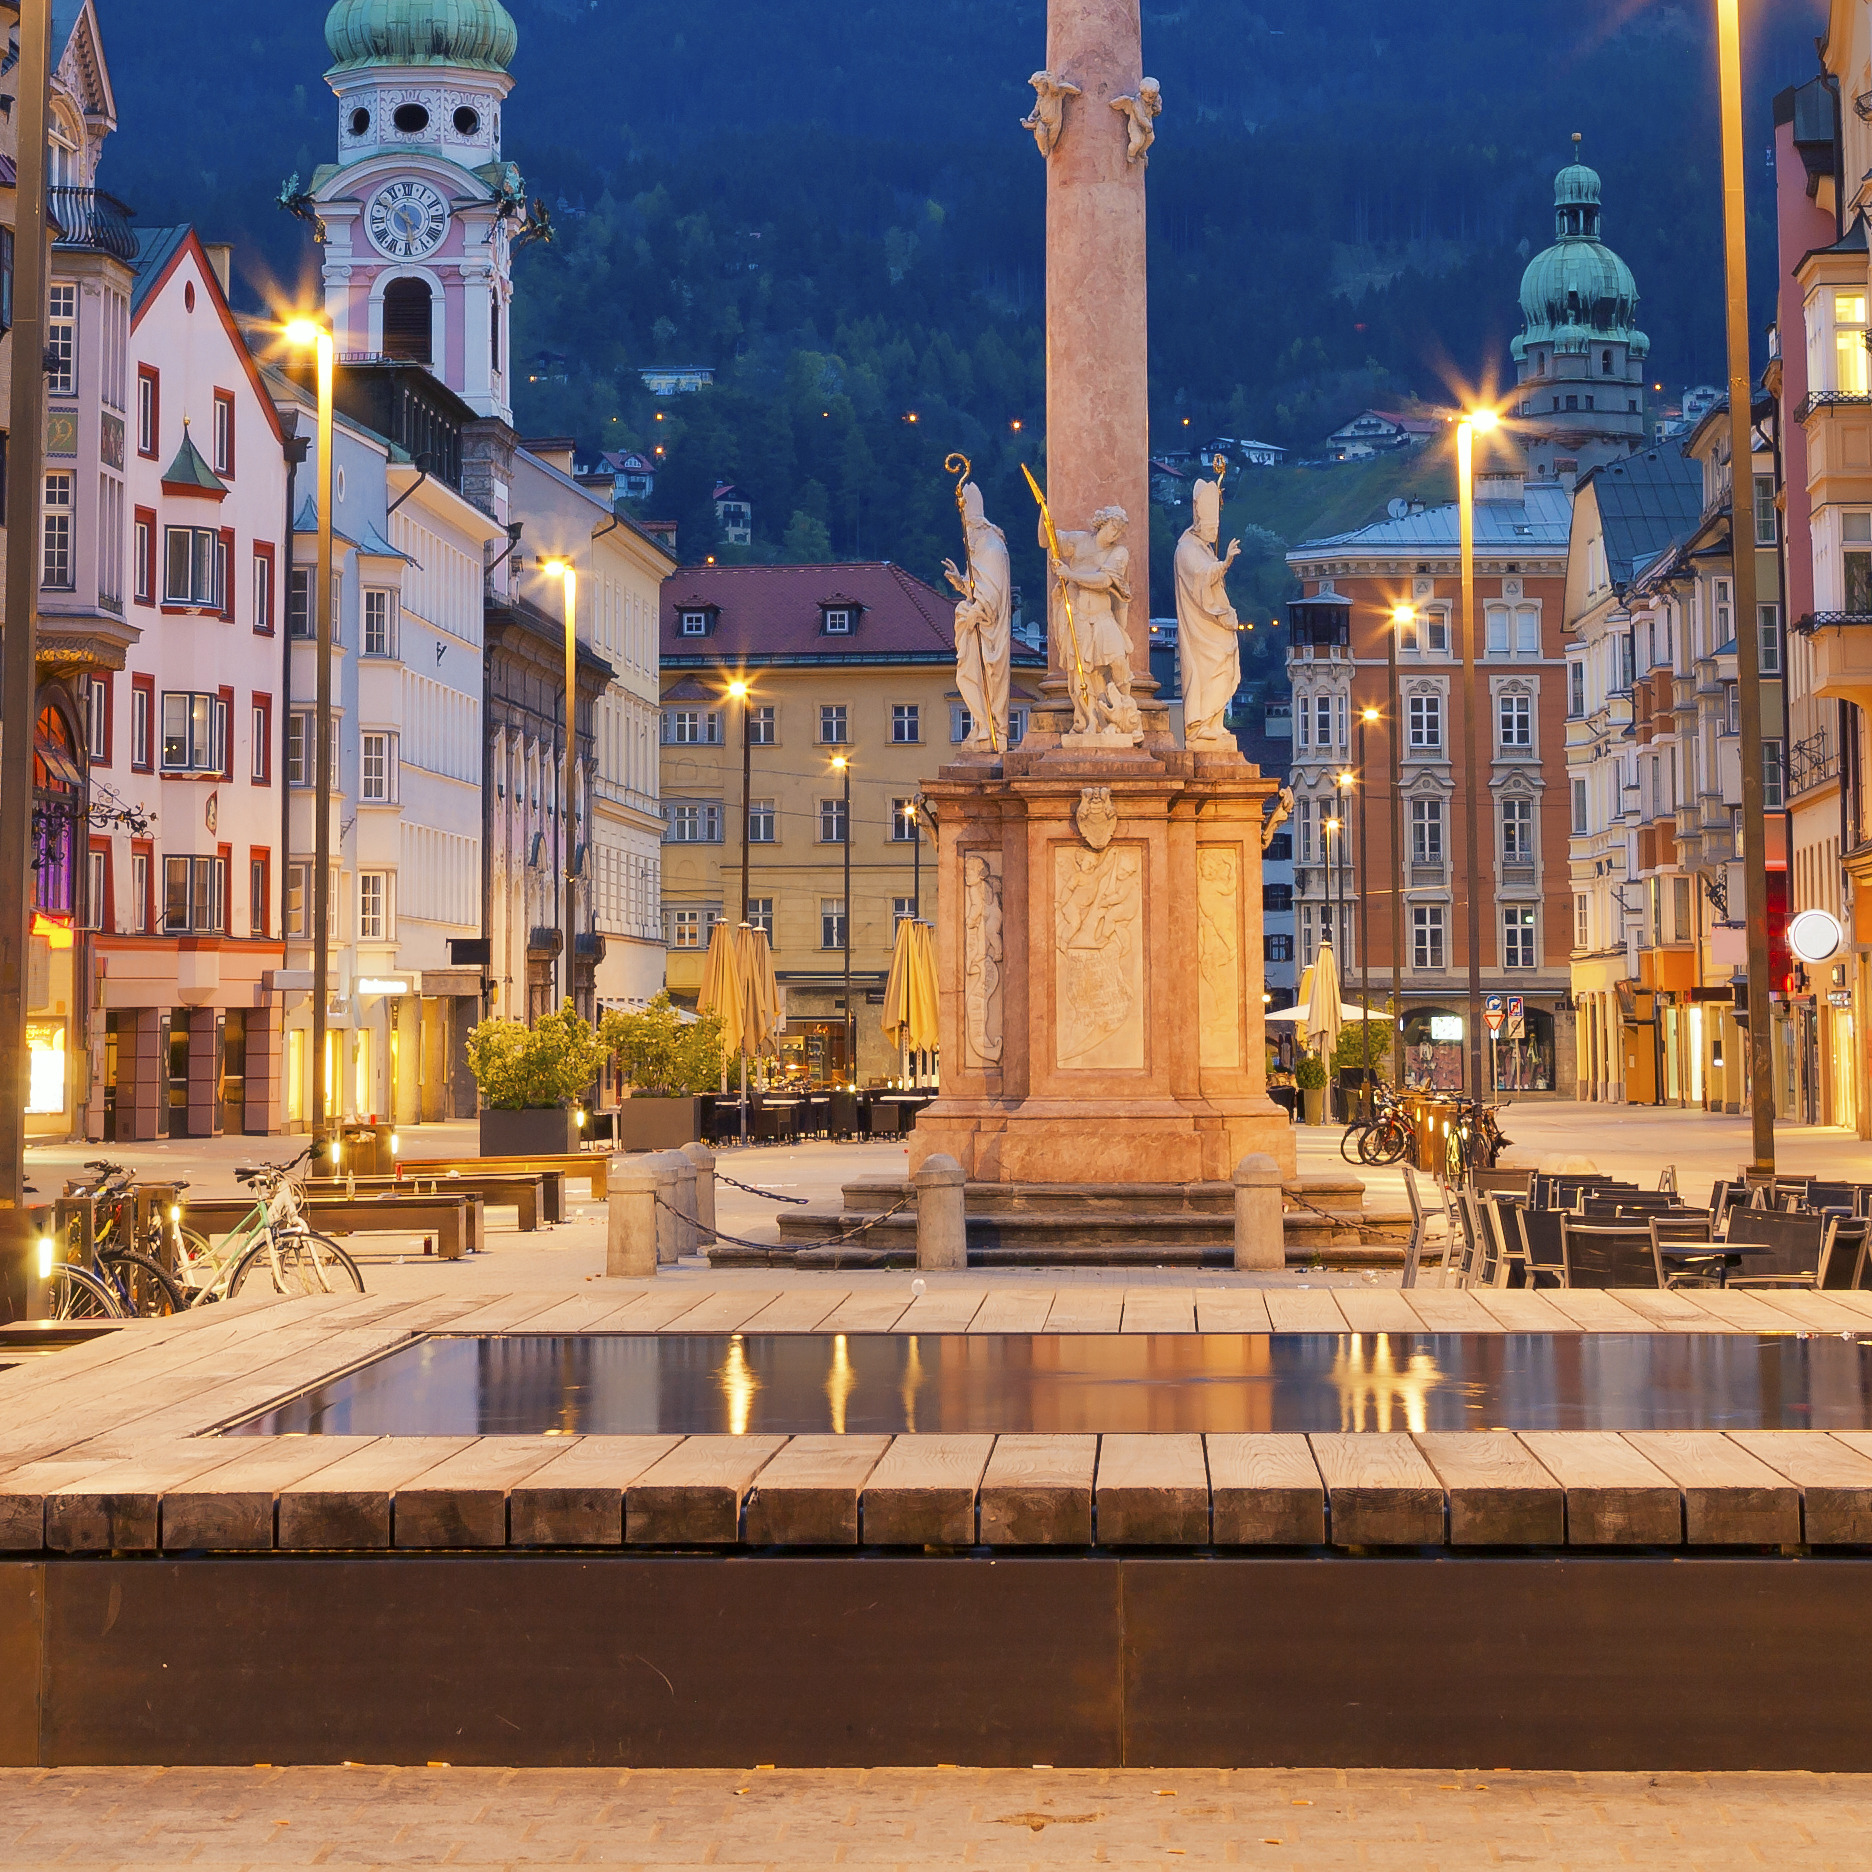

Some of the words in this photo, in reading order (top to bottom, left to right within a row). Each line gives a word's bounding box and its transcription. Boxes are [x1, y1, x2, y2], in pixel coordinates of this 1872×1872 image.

[386, 186, 398, 201] XI
[402, 184, 413, 196] XII
[427, 199, 440, 209] II
[431, 214, 443, 223] III
